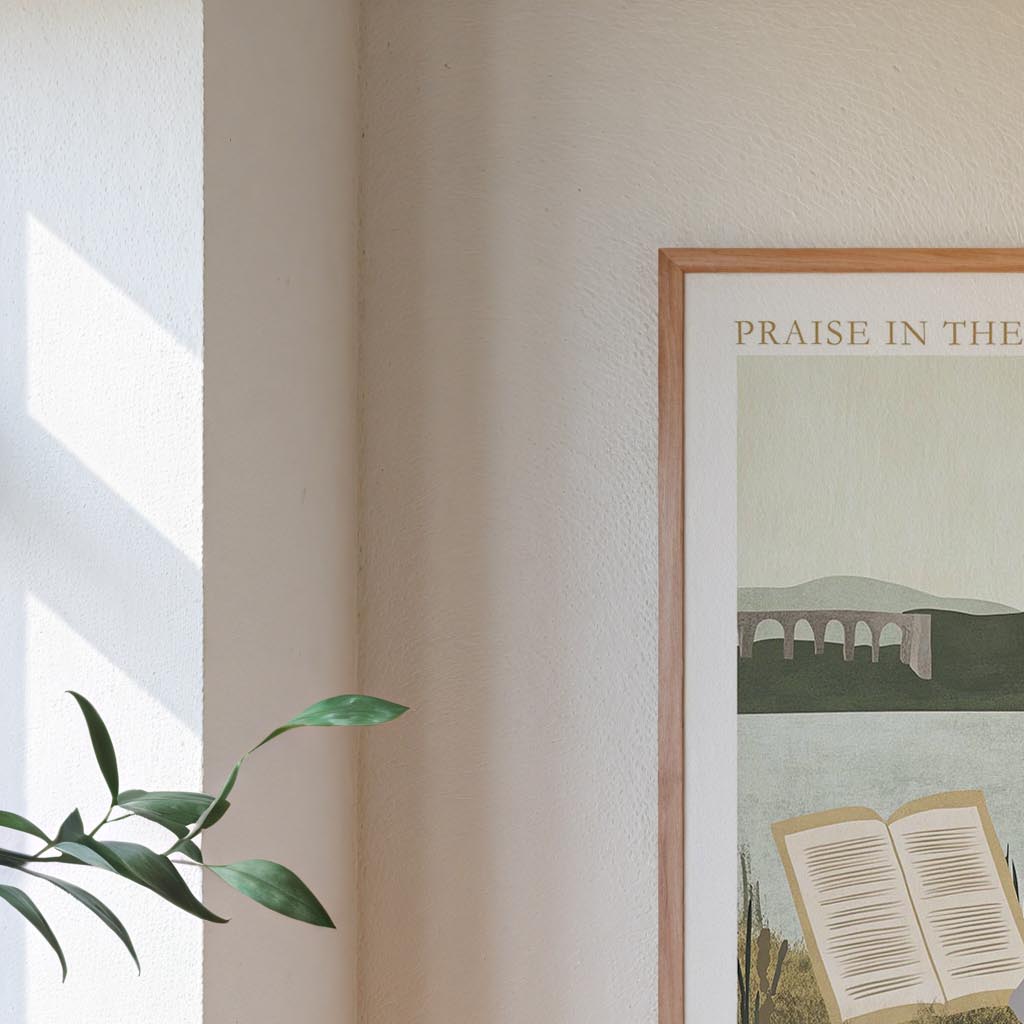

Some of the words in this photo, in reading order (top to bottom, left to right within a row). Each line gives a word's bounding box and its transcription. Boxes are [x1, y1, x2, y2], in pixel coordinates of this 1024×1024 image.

[736, 320, 869, 346] PRAISE
[886, 320, 928, 346] IN
[943, 320, 1023, 346] THE
